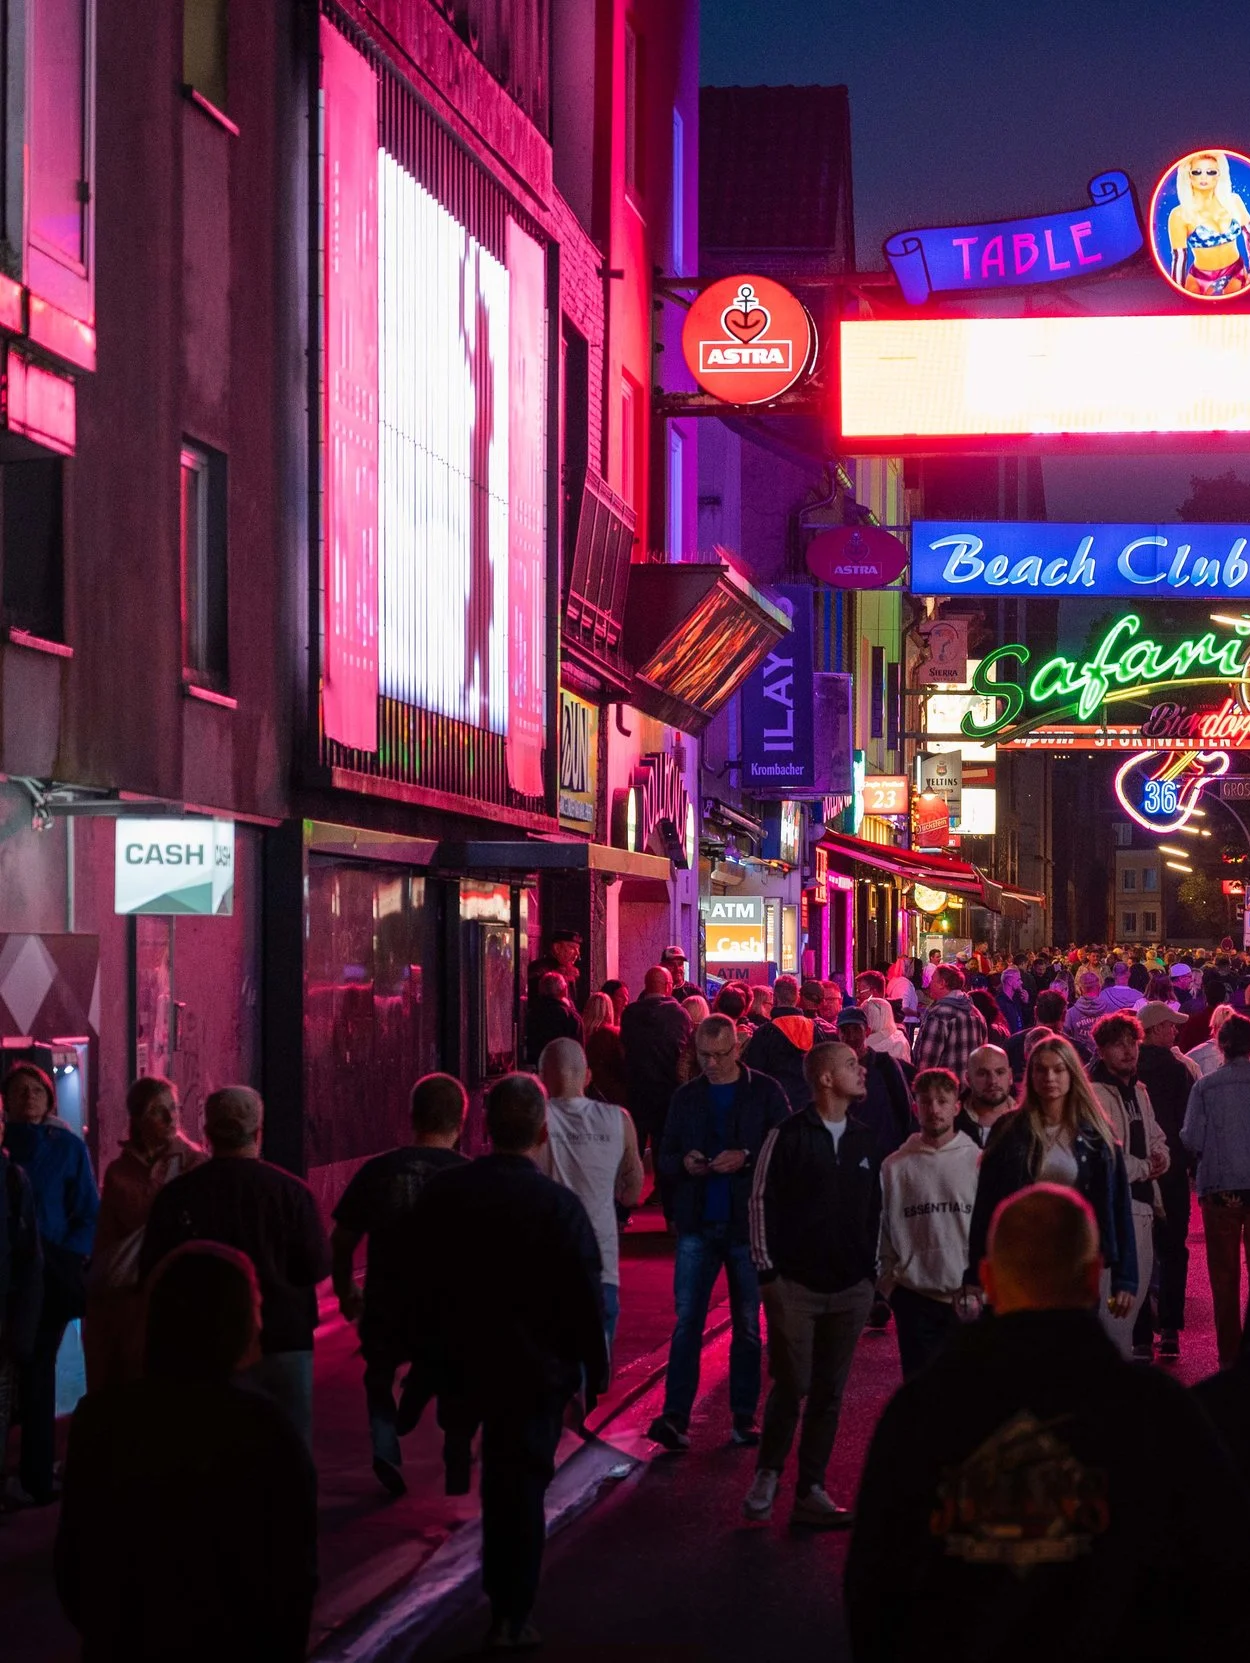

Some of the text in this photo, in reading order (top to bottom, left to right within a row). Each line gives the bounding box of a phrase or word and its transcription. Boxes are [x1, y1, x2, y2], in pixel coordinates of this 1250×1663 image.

[952, 220, 1102, 281] TABLE
[707, 347, 785, 365] ASTRA
[929, 533, 1250, 589] Beach Club
[834, 565, 878, 576] ASTRA
[763, 652, 794, 752] ILAY
[751, 762, 805, 777] Krombacher
[926, 778, 958, 786] VELTINS
[872, 789, 897, 809] 23
[1144, 780, 1178, 814] 36
[125, 843, 204, 866] CASH
[711, 903, 754, 918] ATM
[716, 938, 762, 954] Cash
[717, 967, 749, 979] ATM
[904, 1201, 973, 1219] ESSENTIALS
